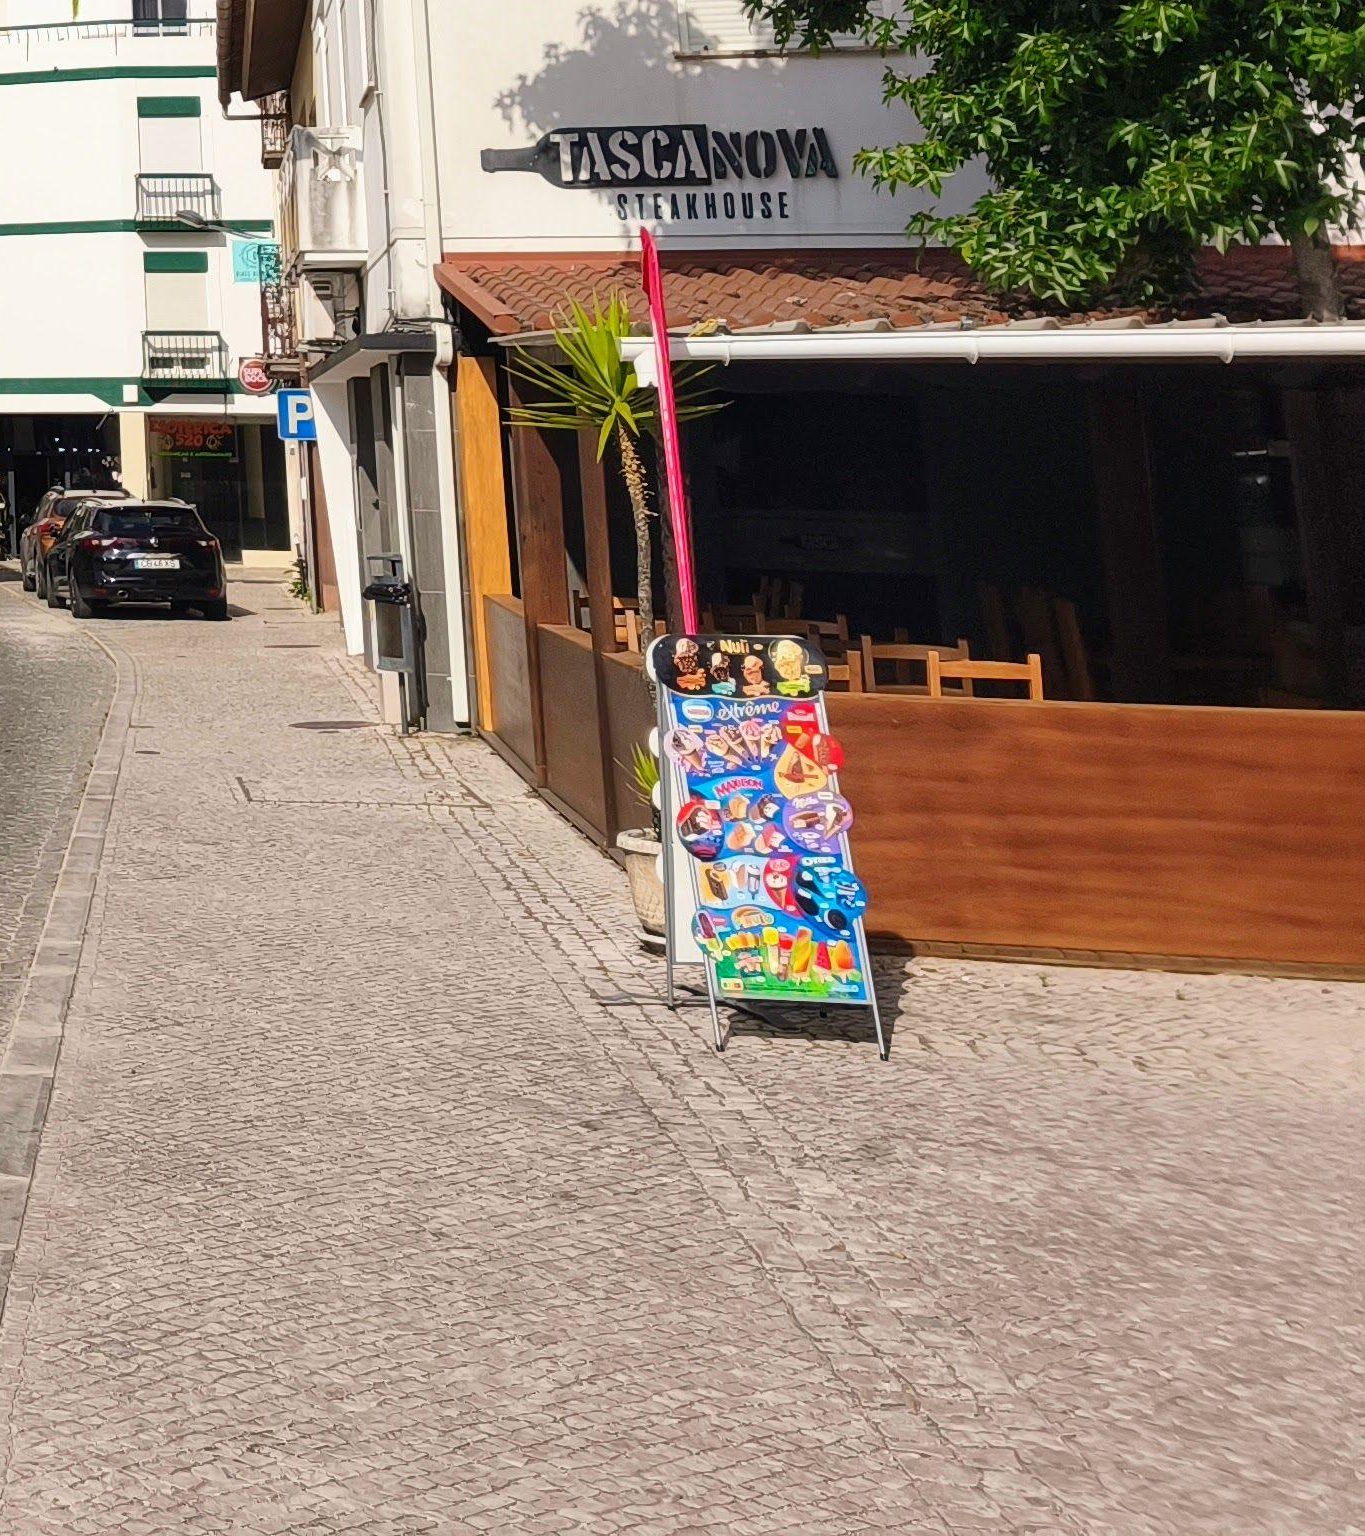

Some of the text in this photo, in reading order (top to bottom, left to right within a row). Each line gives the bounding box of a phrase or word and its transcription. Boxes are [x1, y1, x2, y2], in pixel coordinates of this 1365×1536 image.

[616, 191, 790, 221] STEAKHOUSE
[287, 395, 314, 434] P
[716, 700, 783, 721] extrême
